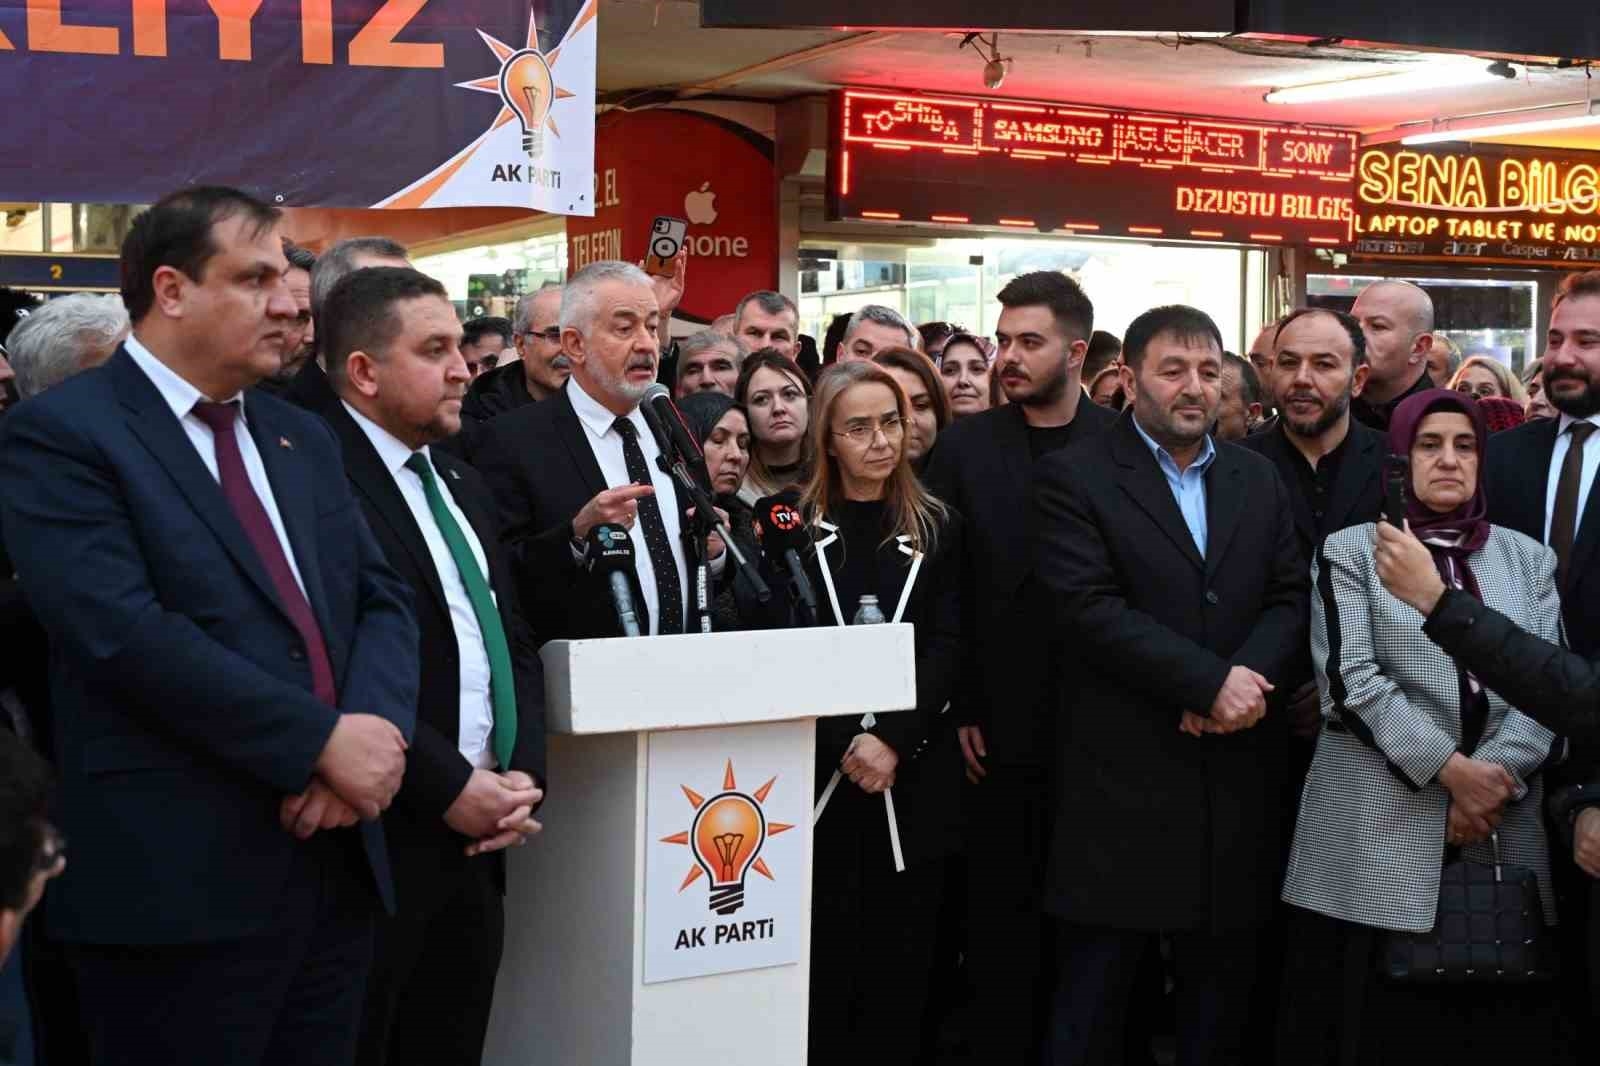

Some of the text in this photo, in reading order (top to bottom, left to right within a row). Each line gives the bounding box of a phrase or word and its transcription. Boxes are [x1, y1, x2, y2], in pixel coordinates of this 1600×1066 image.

[1282, 140, 1333, 164] SONY
[491, 164, 522, 182] AK
[1359, 150, 1487, 209] SENA
[605, 168, 620, 207] EL
[1176, 187, 1276, 217] DIZUSTU
[1355, 214, 1440, 235] LAPTOP
[1445, 218, 1523, 239] TABLET
[1530, 222, 1556, 241] VE
[674, 926, 707, 951] AK
